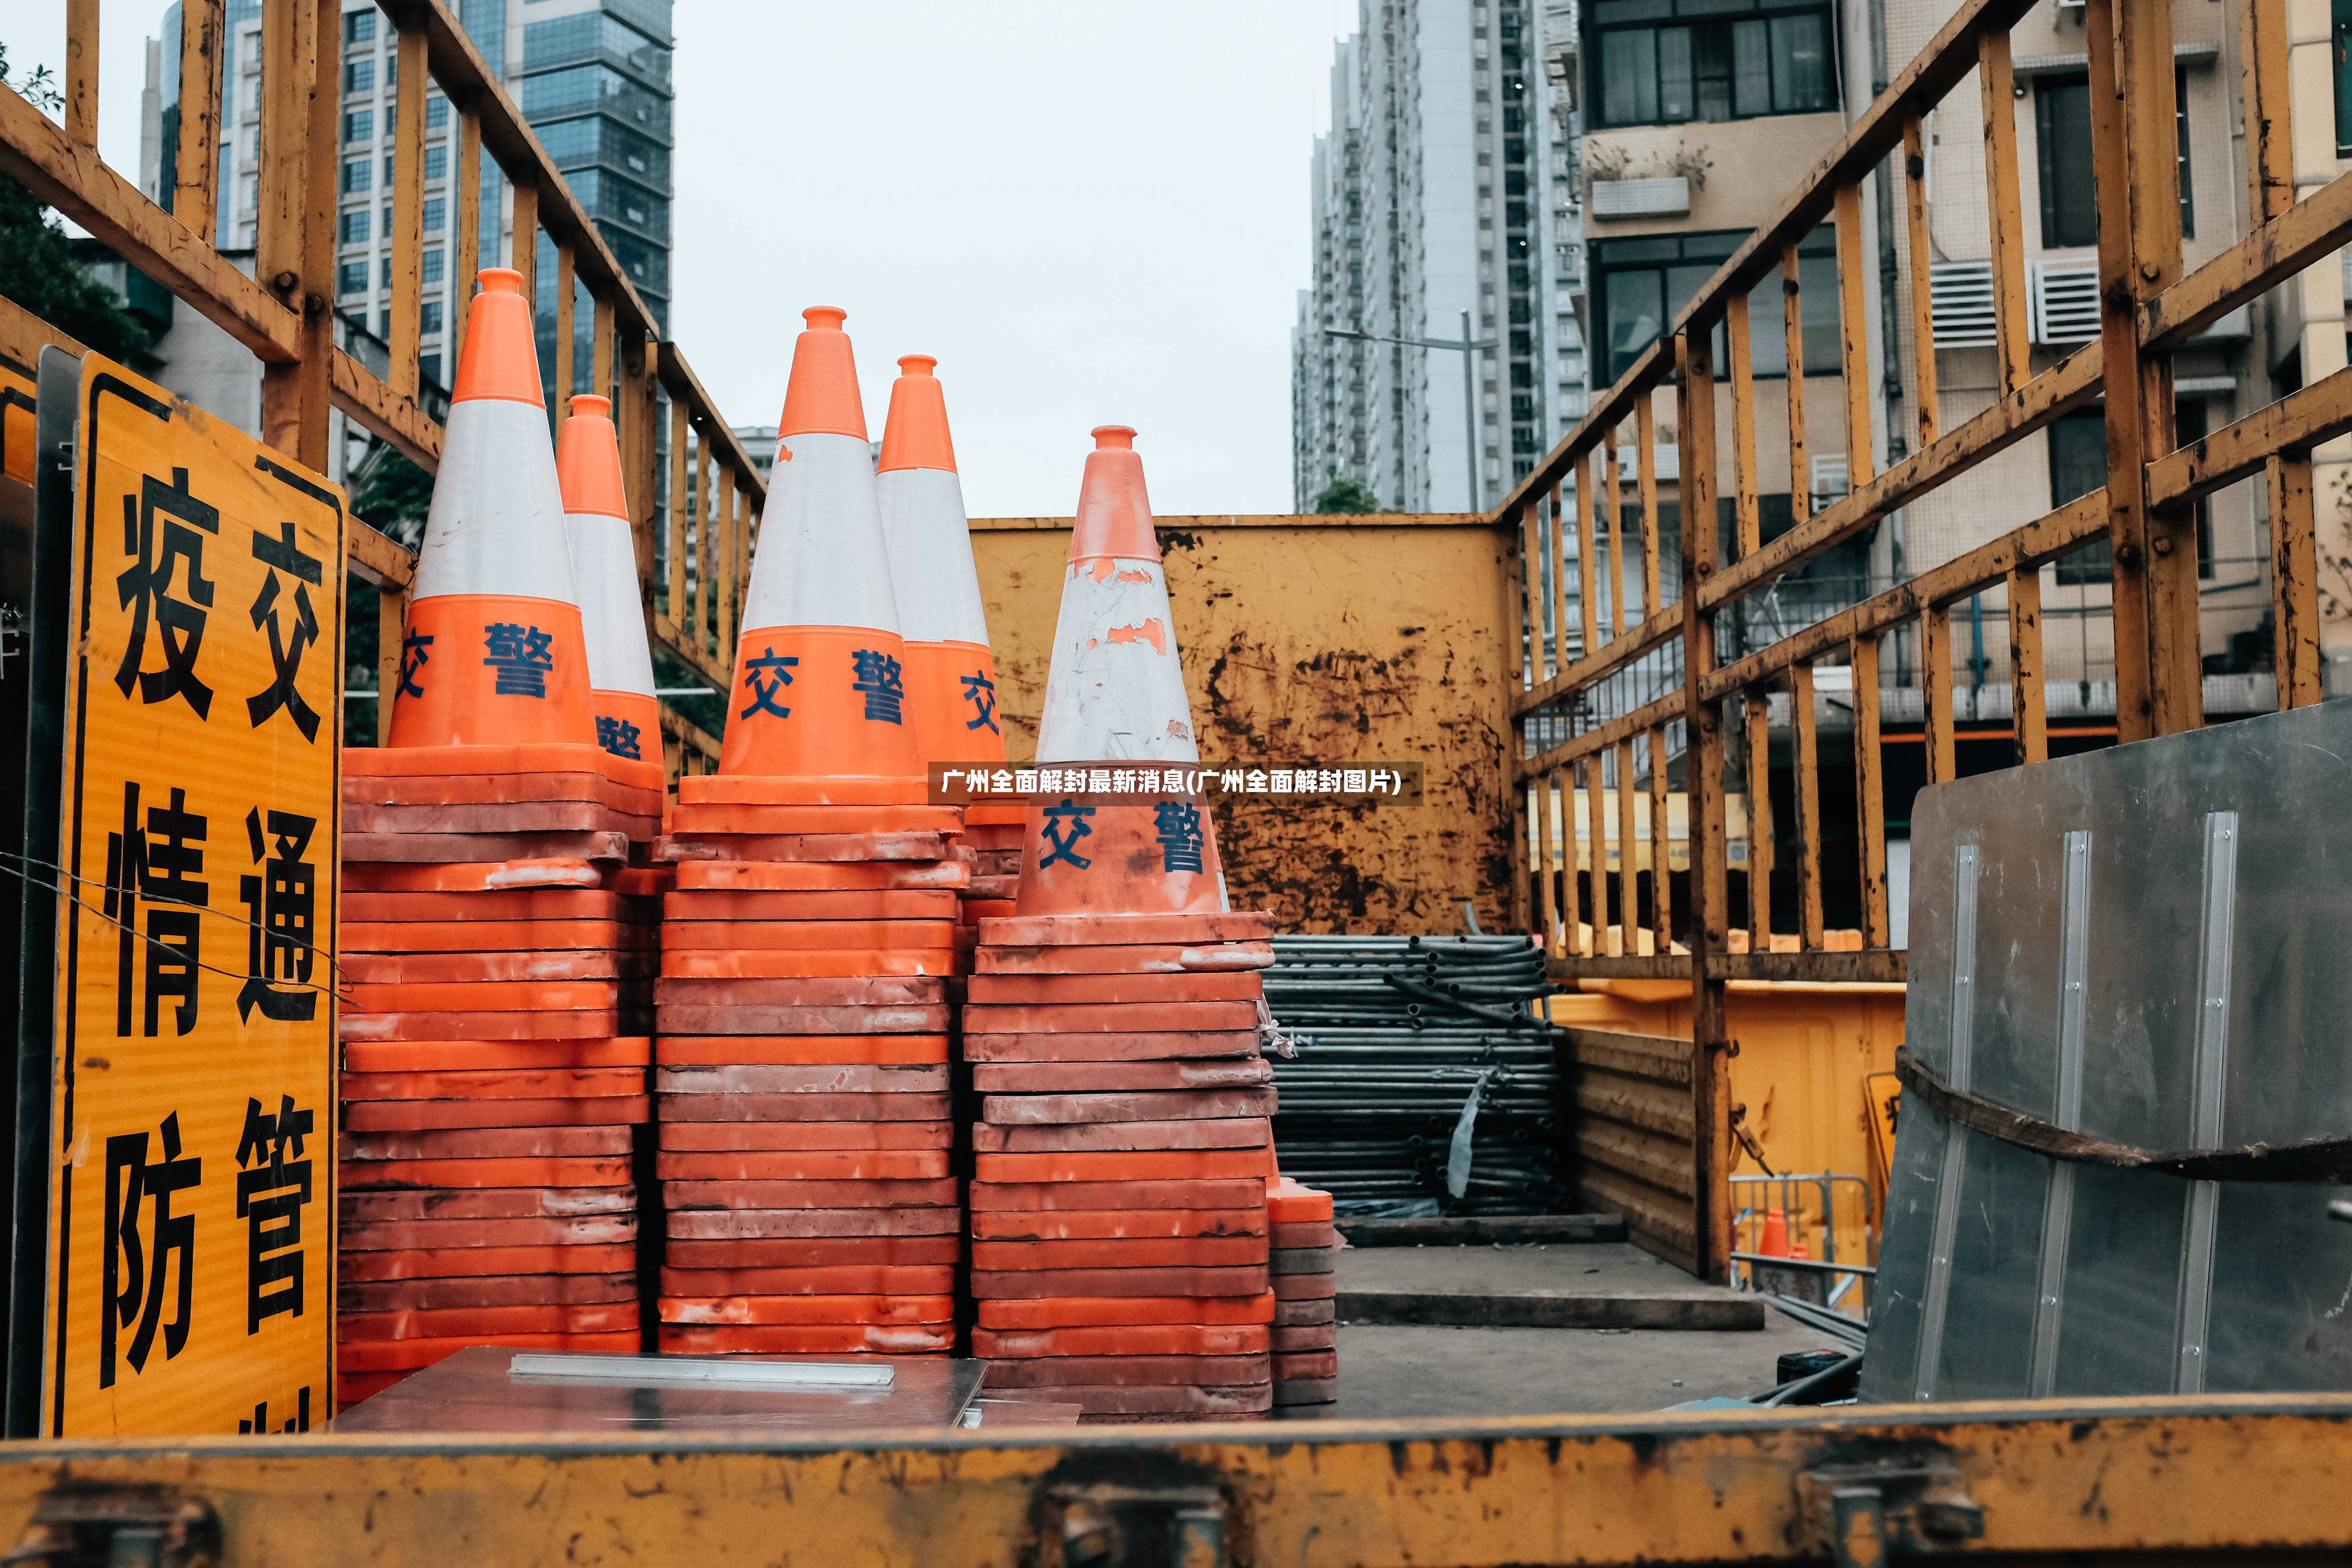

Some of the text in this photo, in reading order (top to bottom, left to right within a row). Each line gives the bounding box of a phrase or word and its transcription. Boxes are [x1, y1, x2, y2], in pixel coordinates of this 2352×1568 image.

[741, 647, 904, 725] 交警
[961, 670, 999, 735] 交
[1040, 798, 1205, 875] 交警
[100, 467, 219, 1390] 疫情防
[235, 522, 322, 1435] 交通管
